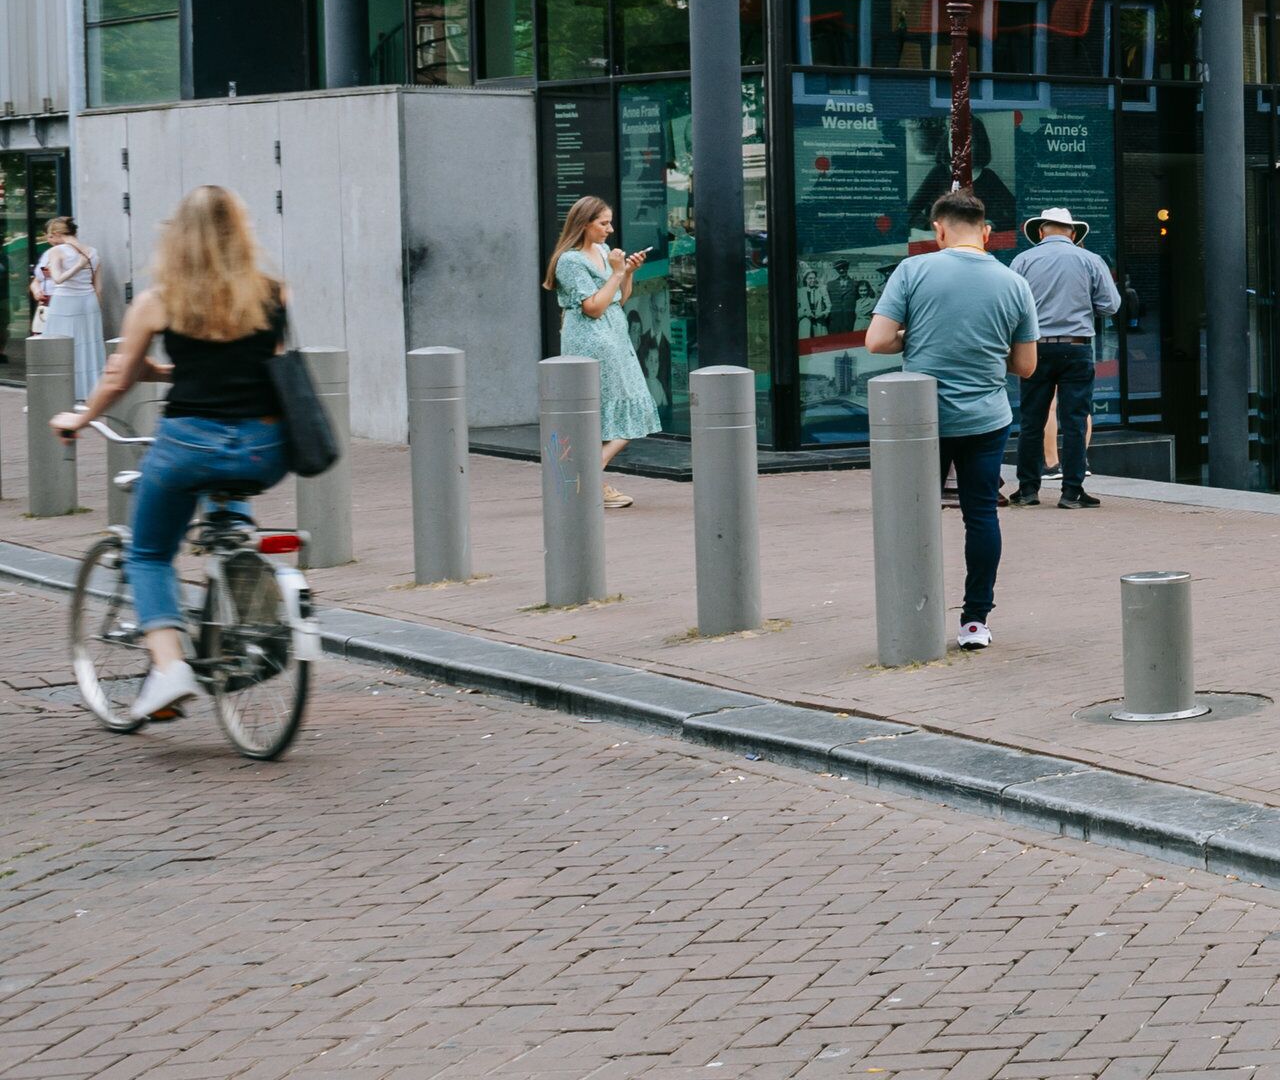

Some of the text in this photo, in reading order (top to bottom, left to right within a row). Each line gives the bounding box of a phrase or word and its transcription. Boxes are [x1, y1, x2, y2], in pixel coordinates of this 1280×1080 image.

[825, 98, 874, 112] Annes
[822, 116, 878, 129] Wereld
[1044, 123, 1088, 136] Anne's
[1047, 140, 1085, 152] World
